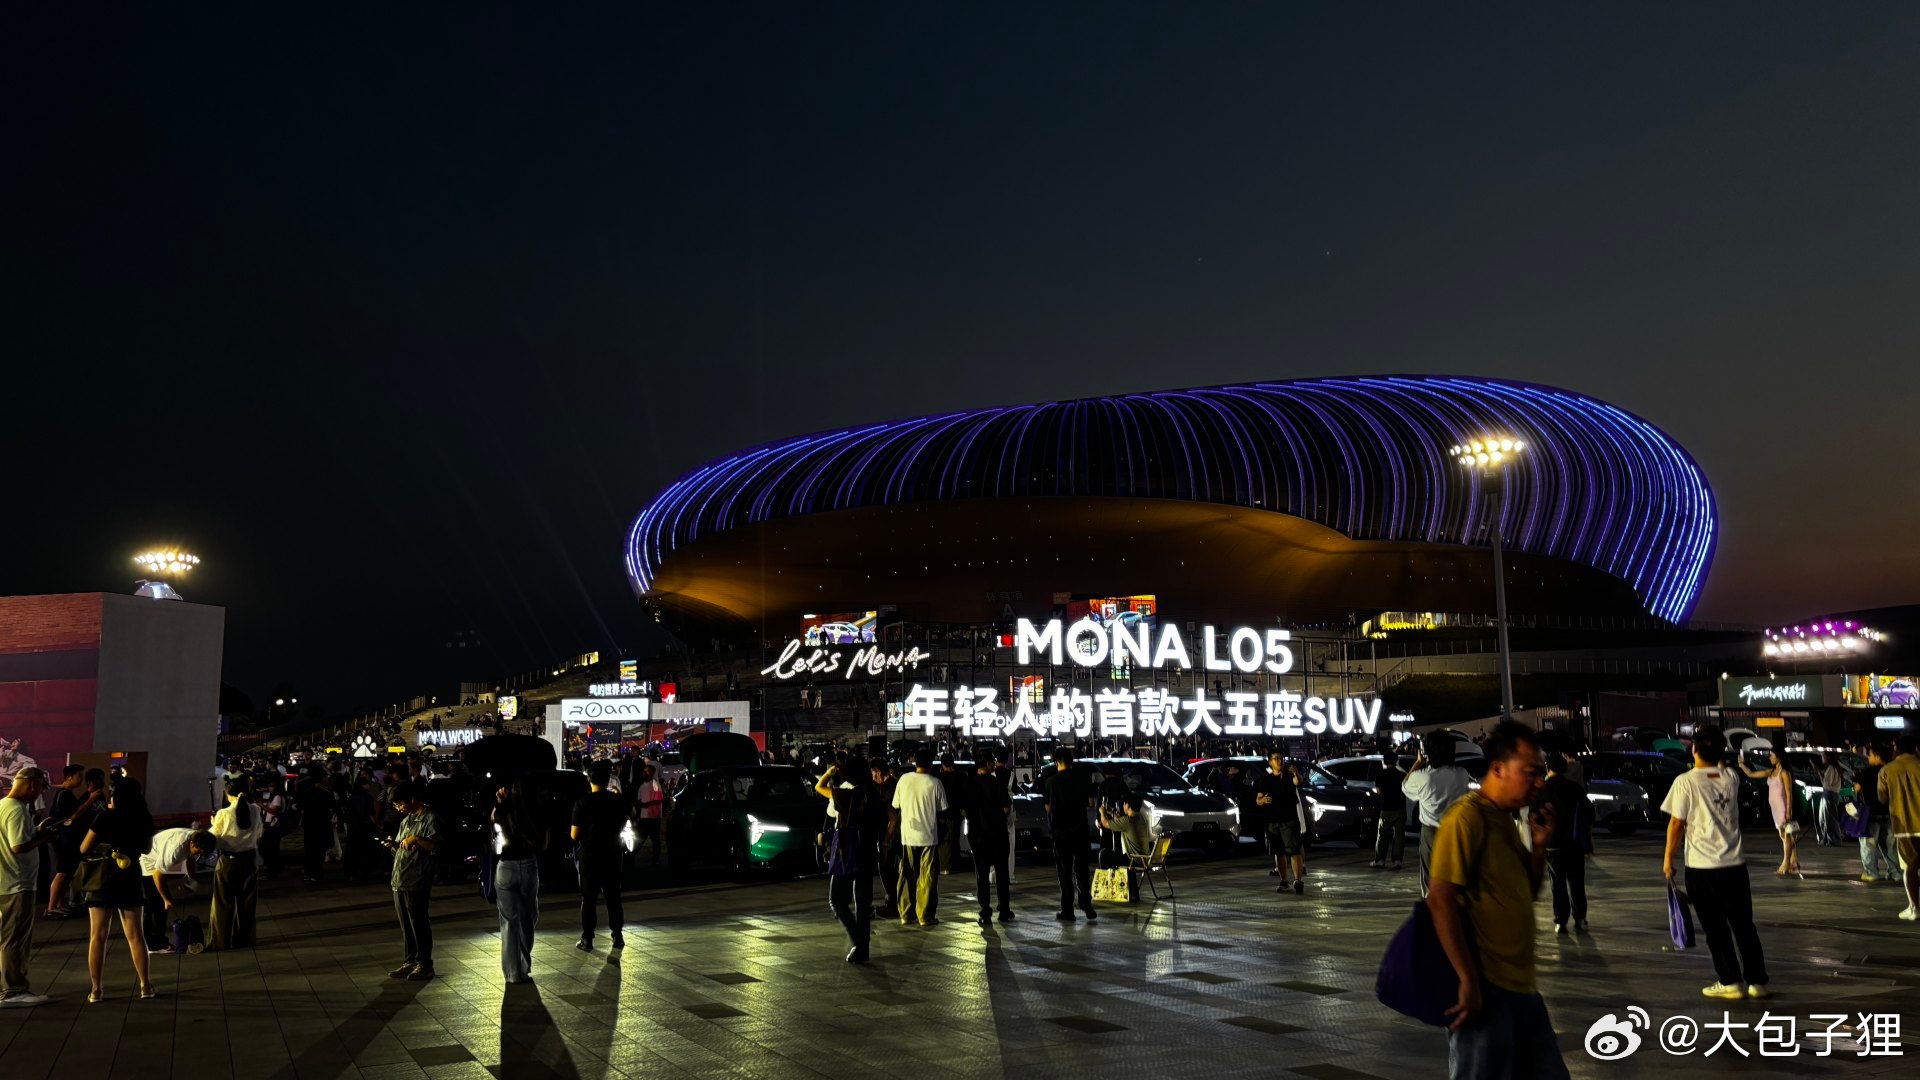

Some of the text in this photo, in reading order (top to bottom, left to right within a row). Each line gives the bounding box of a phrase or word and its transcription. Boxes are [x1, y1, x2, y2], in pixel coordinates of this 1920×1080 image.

[761, 639, 842, 679] Let's
[1017, 619, 1190, 668] MONA
[904, 683, 1381, 738] 年轻人的首款大五座SUV
